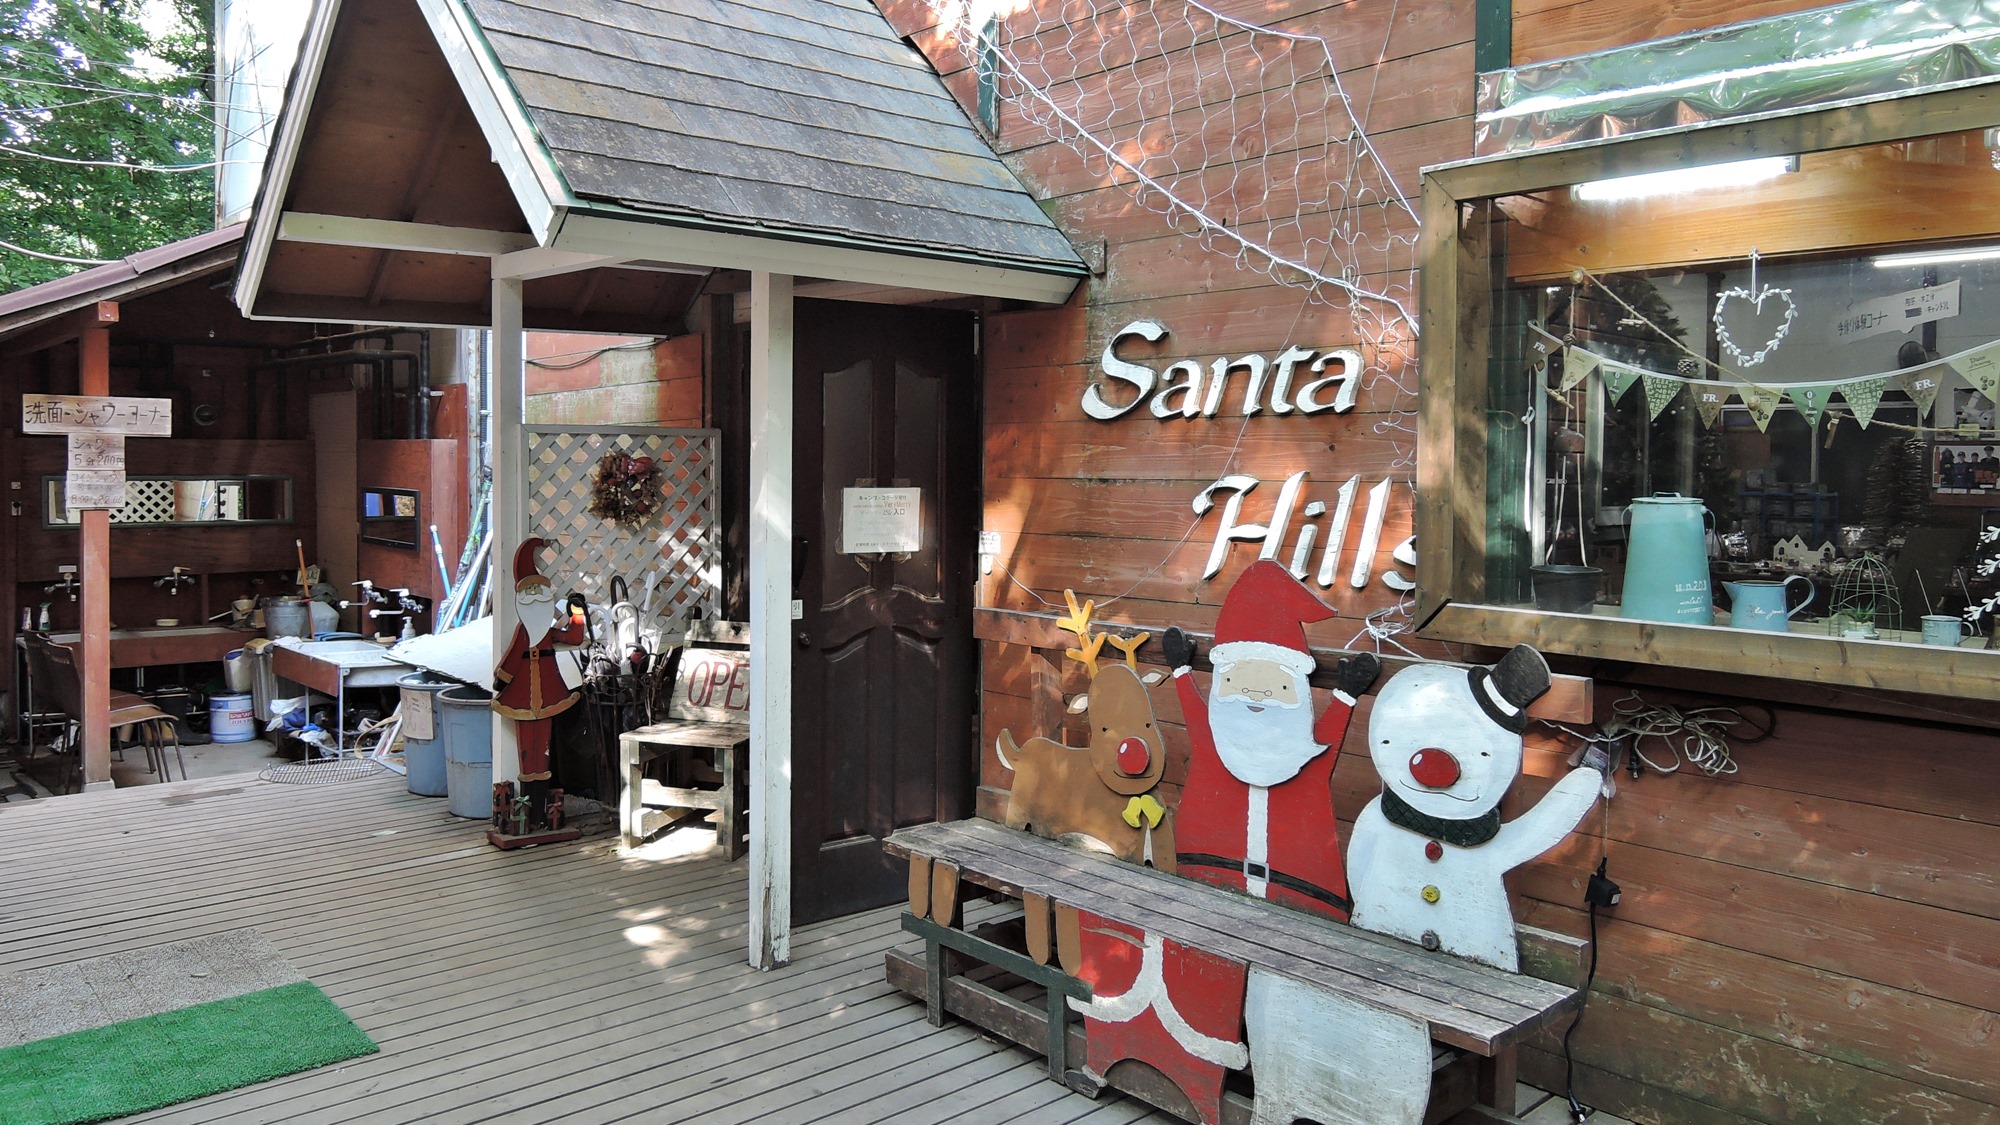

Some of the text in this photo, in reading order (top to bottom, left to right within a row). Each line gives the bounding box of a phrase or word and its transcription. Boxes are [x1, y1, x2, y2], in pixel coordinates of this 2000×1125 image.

[1080, 318, 1365, 421] Santa
[1914, 378, 1936, 391] FR.
[1702, 393, 1719, 403] FR.
[688, 660, 750, 711] OPE
